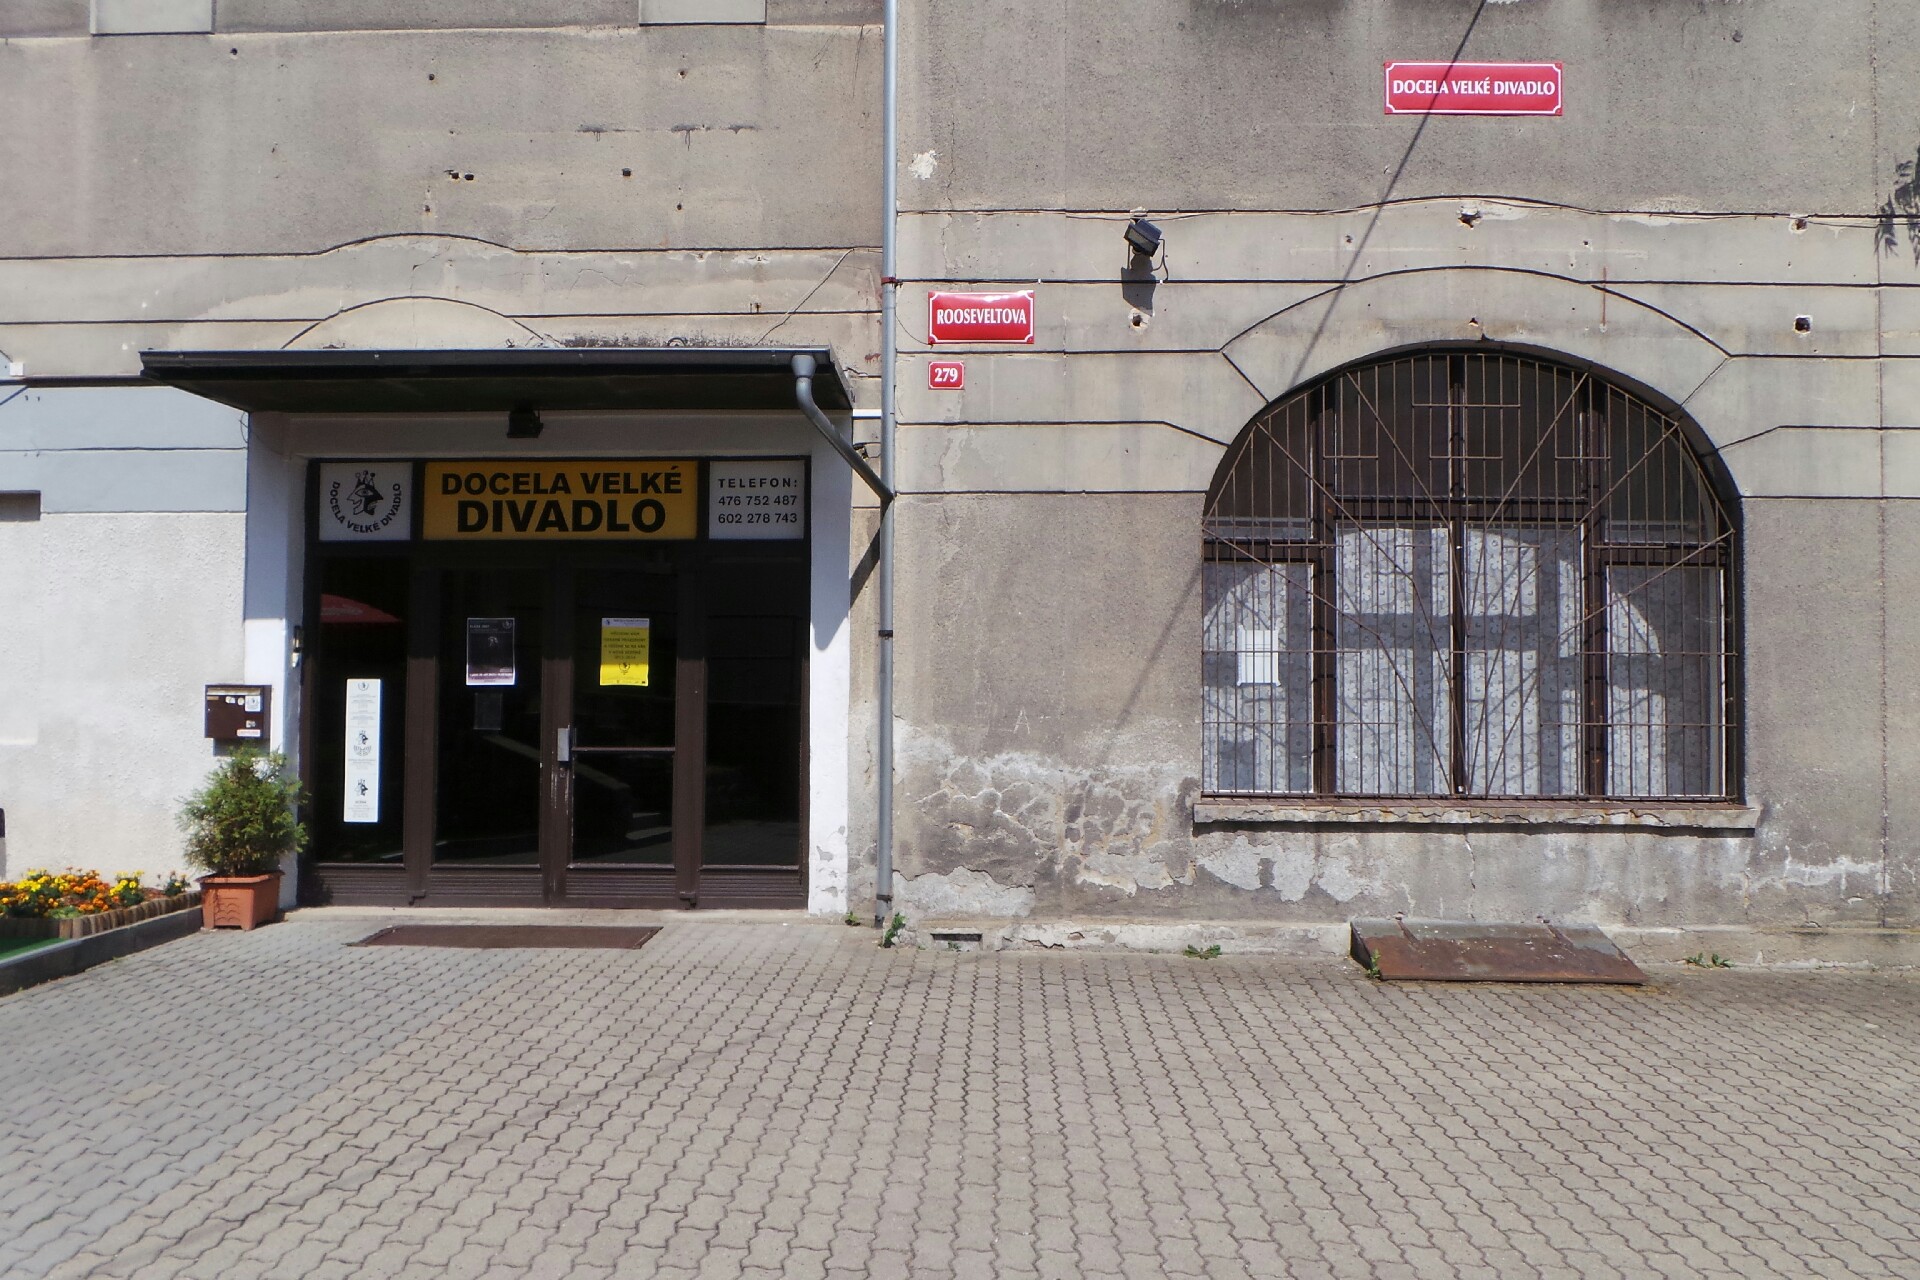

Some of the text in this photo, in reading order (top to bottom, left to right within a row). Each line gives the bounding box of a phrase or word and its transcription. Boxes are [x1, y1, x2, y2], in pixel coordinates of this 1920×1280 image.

[1393, 77, 1555, 95] DOCELA VELKÉ DIVADLO
[936, 308, 1026, 324] ROOSEVELTOVA
[934, 367, 958, 382] 279
[441, 465, 682, 495] DOCELA VELKÉ
[718, 478, 797, 488] TELEFON:
[330, 481, 402, 533] DOCELA VELKÉ DIVADLO
[718, 495, 797, 506] 476 752 487
[457, 499, 666, 533] DIVADLO
[718, 513, 798, 524] 602 278 743
